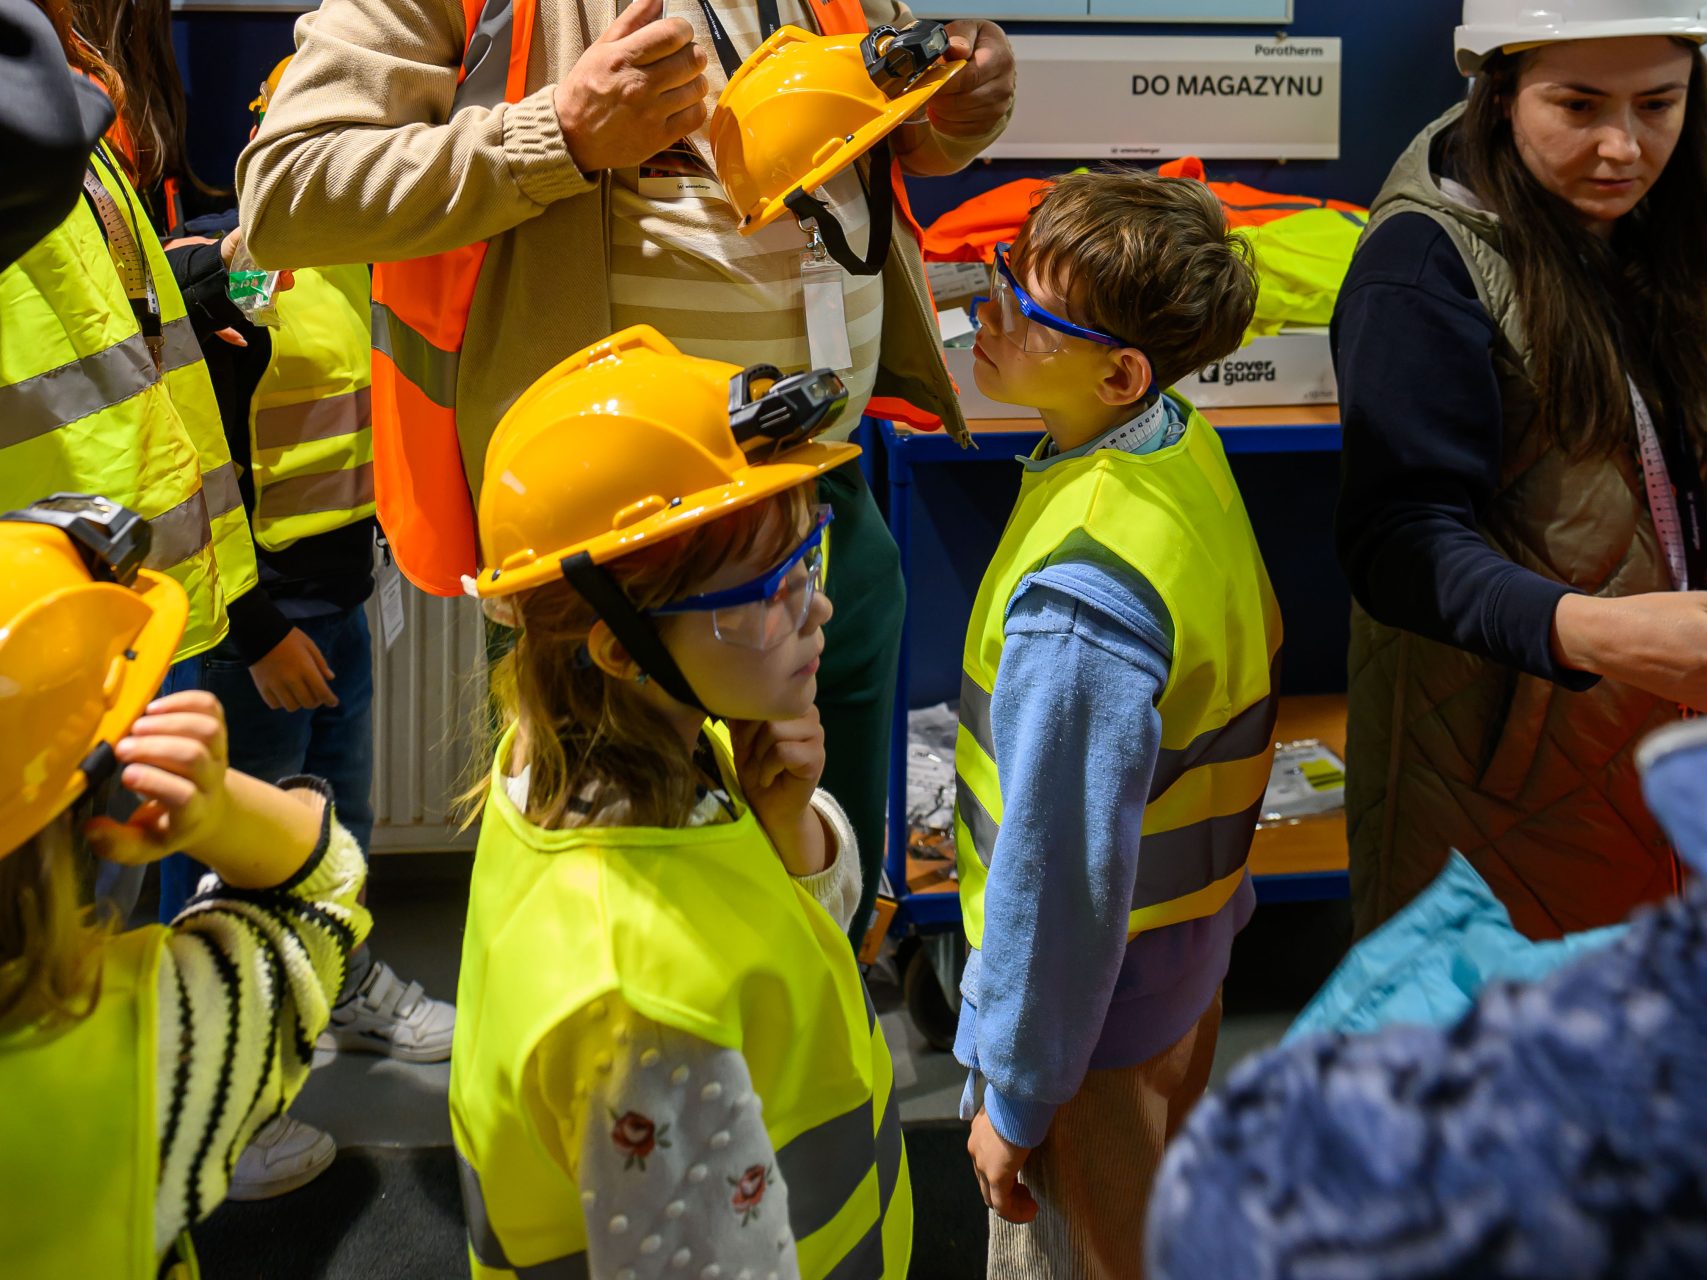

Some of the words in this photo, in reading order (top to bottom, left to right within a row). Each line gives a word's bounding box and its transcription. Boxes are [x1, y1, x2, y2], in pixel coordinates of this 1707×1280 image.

[1254, 43, 1324, 57] Porotherm
[1131, 74, 1171, 97] DO
[1176, 75, 1323, 97] MAGAZYNU
[1224, 360, 1273, 372] cover
[1223, 367, 1276, 386] guard
